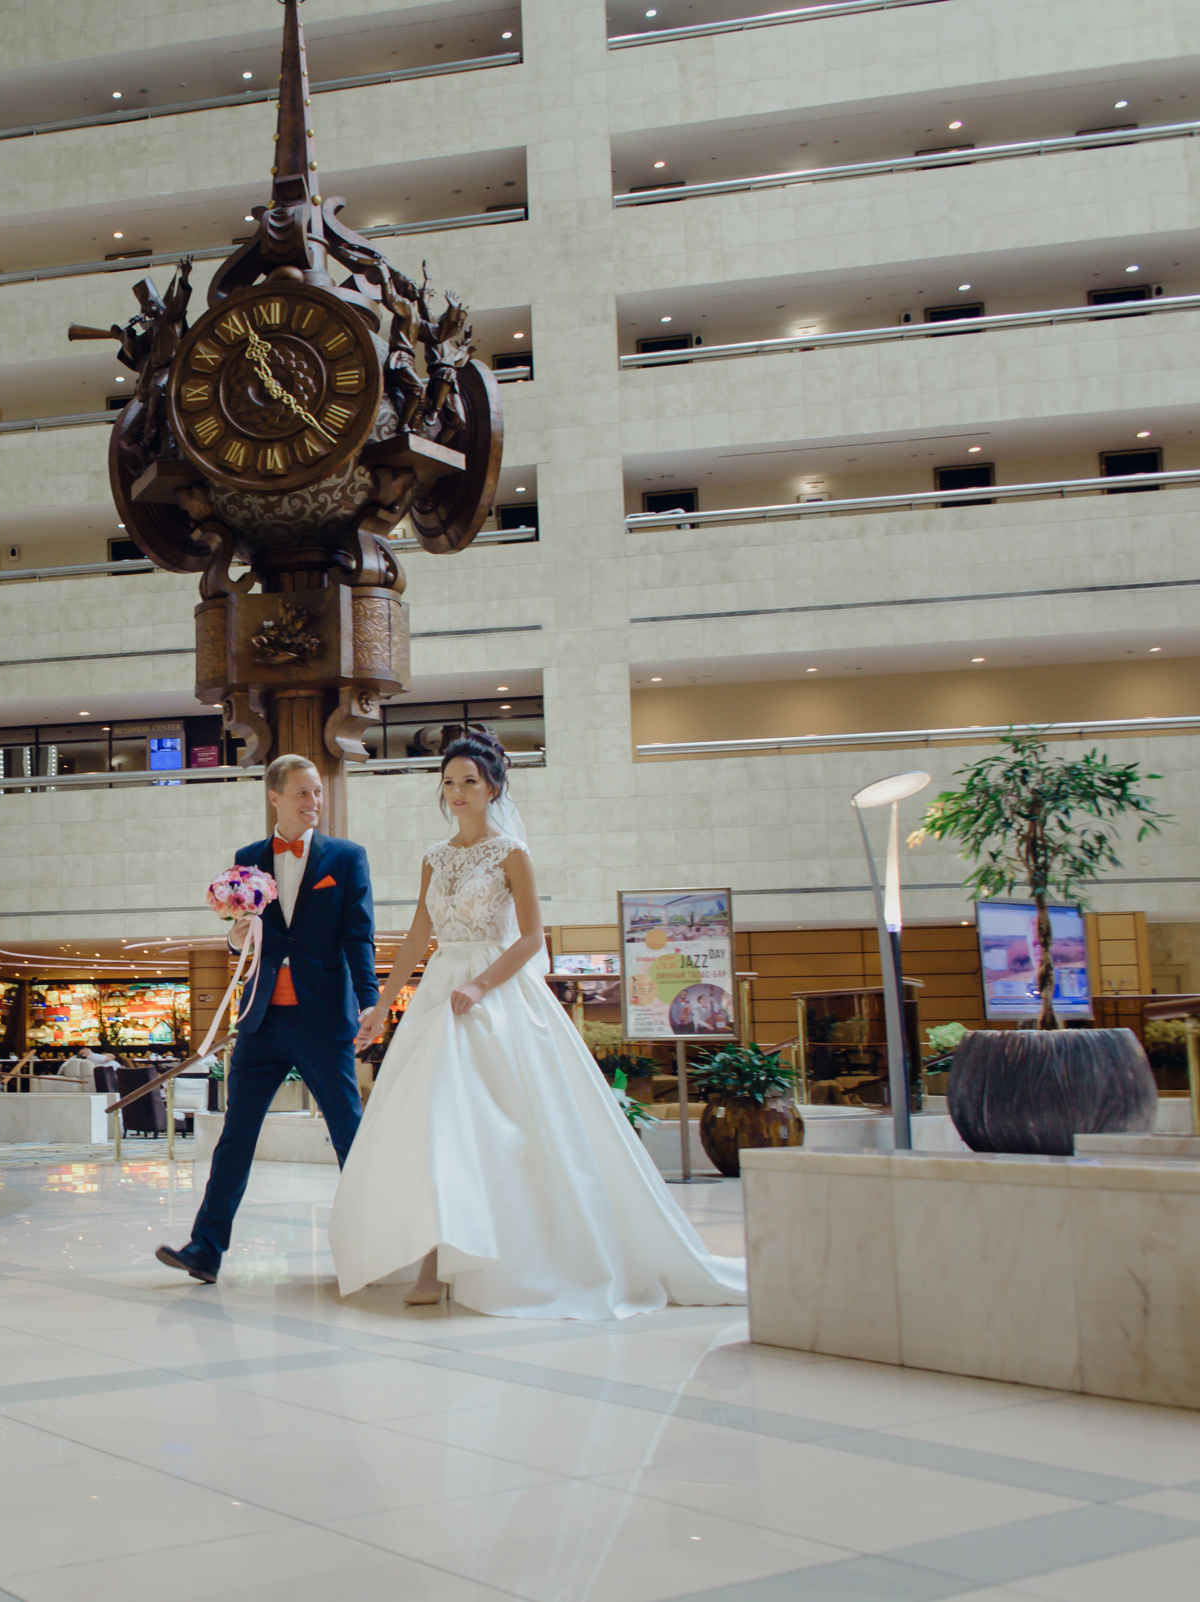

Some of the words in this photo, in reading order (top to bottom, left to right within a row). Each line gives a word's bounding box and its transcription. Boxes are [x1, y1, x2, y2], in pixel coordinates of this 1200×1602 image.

[114, 726, 150, 734] BUSINESS
[152, 724, 182, 732] CENTER
[680, 954, 709, 969] JAZZ
[709, 948, 726, 959] DAY
